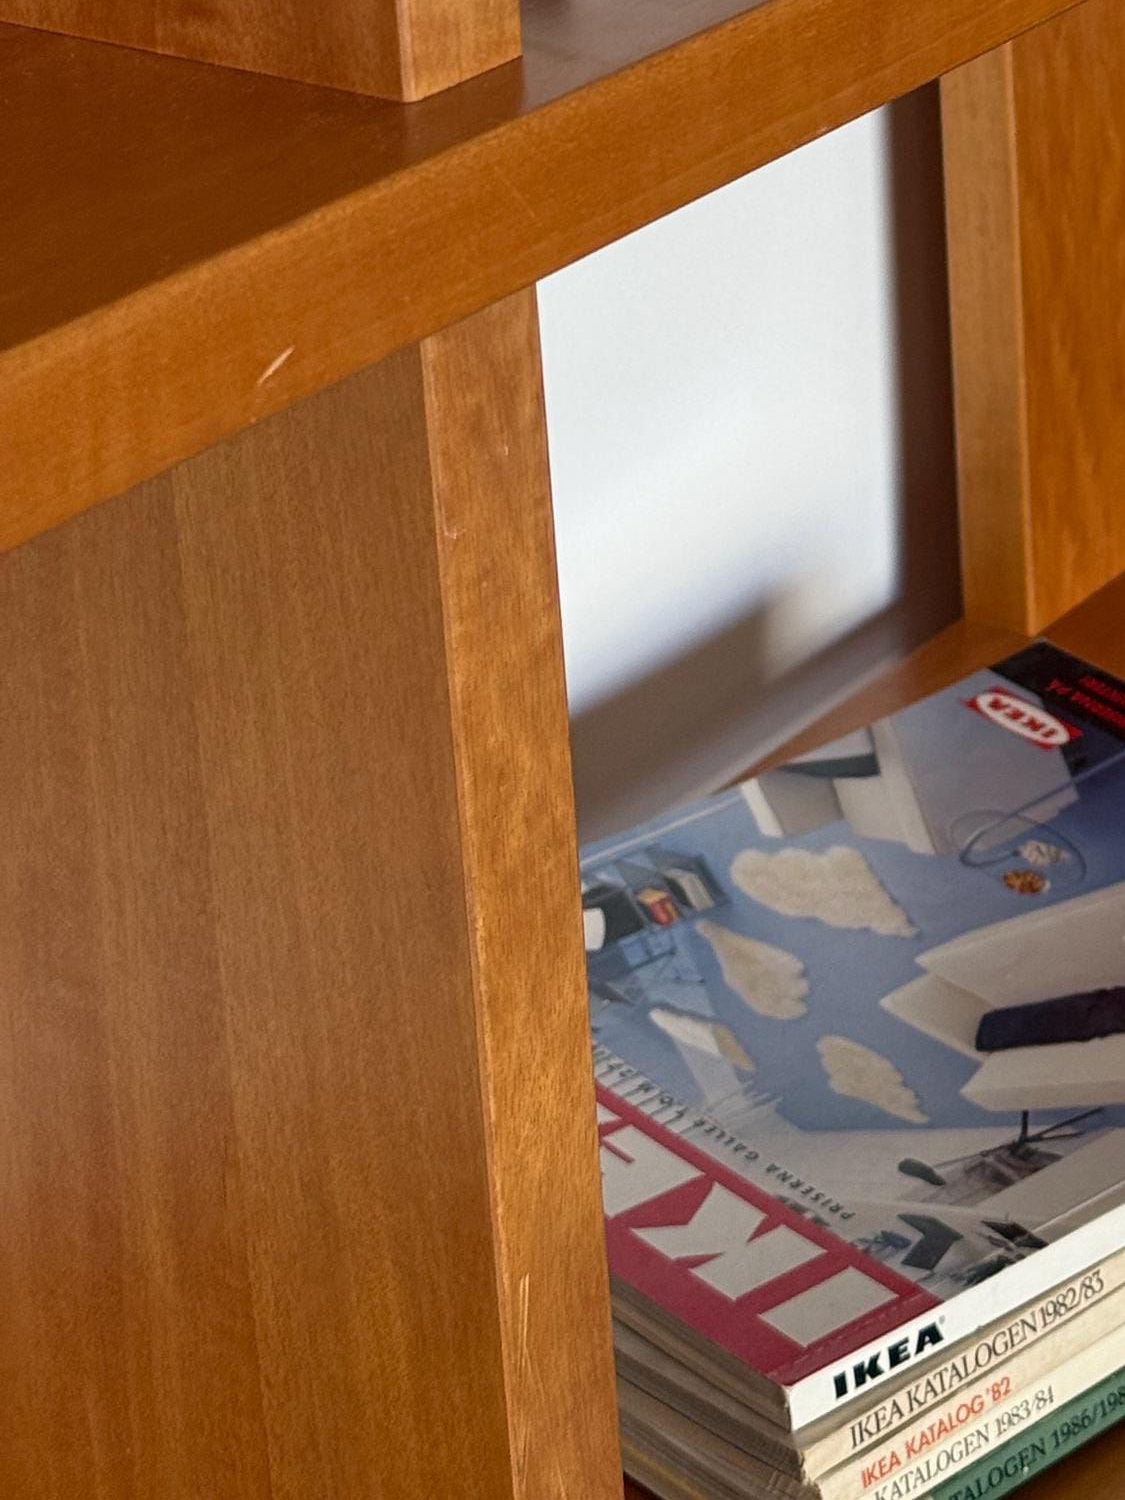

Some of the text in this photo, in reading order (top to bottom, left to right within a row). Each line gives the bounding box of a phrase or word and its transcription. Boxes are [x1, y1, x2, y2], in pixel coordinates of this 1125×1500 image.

[986, 695, 1057, 741] IKEA
[597, 1101, 902, 1349] IKE
[765, 1163, 856, 1221] PRISERNA
[833, 1321, 945, 1400] IKEA
[849, 1269, 1104, 1450] IKEA KATALOGEN 1982/83
[860, 1450, 902, 1490] IKEA
[905, 1394, 986, 1459] KATALOG
[874, 1422, 990, 1500] KATALOGEN
